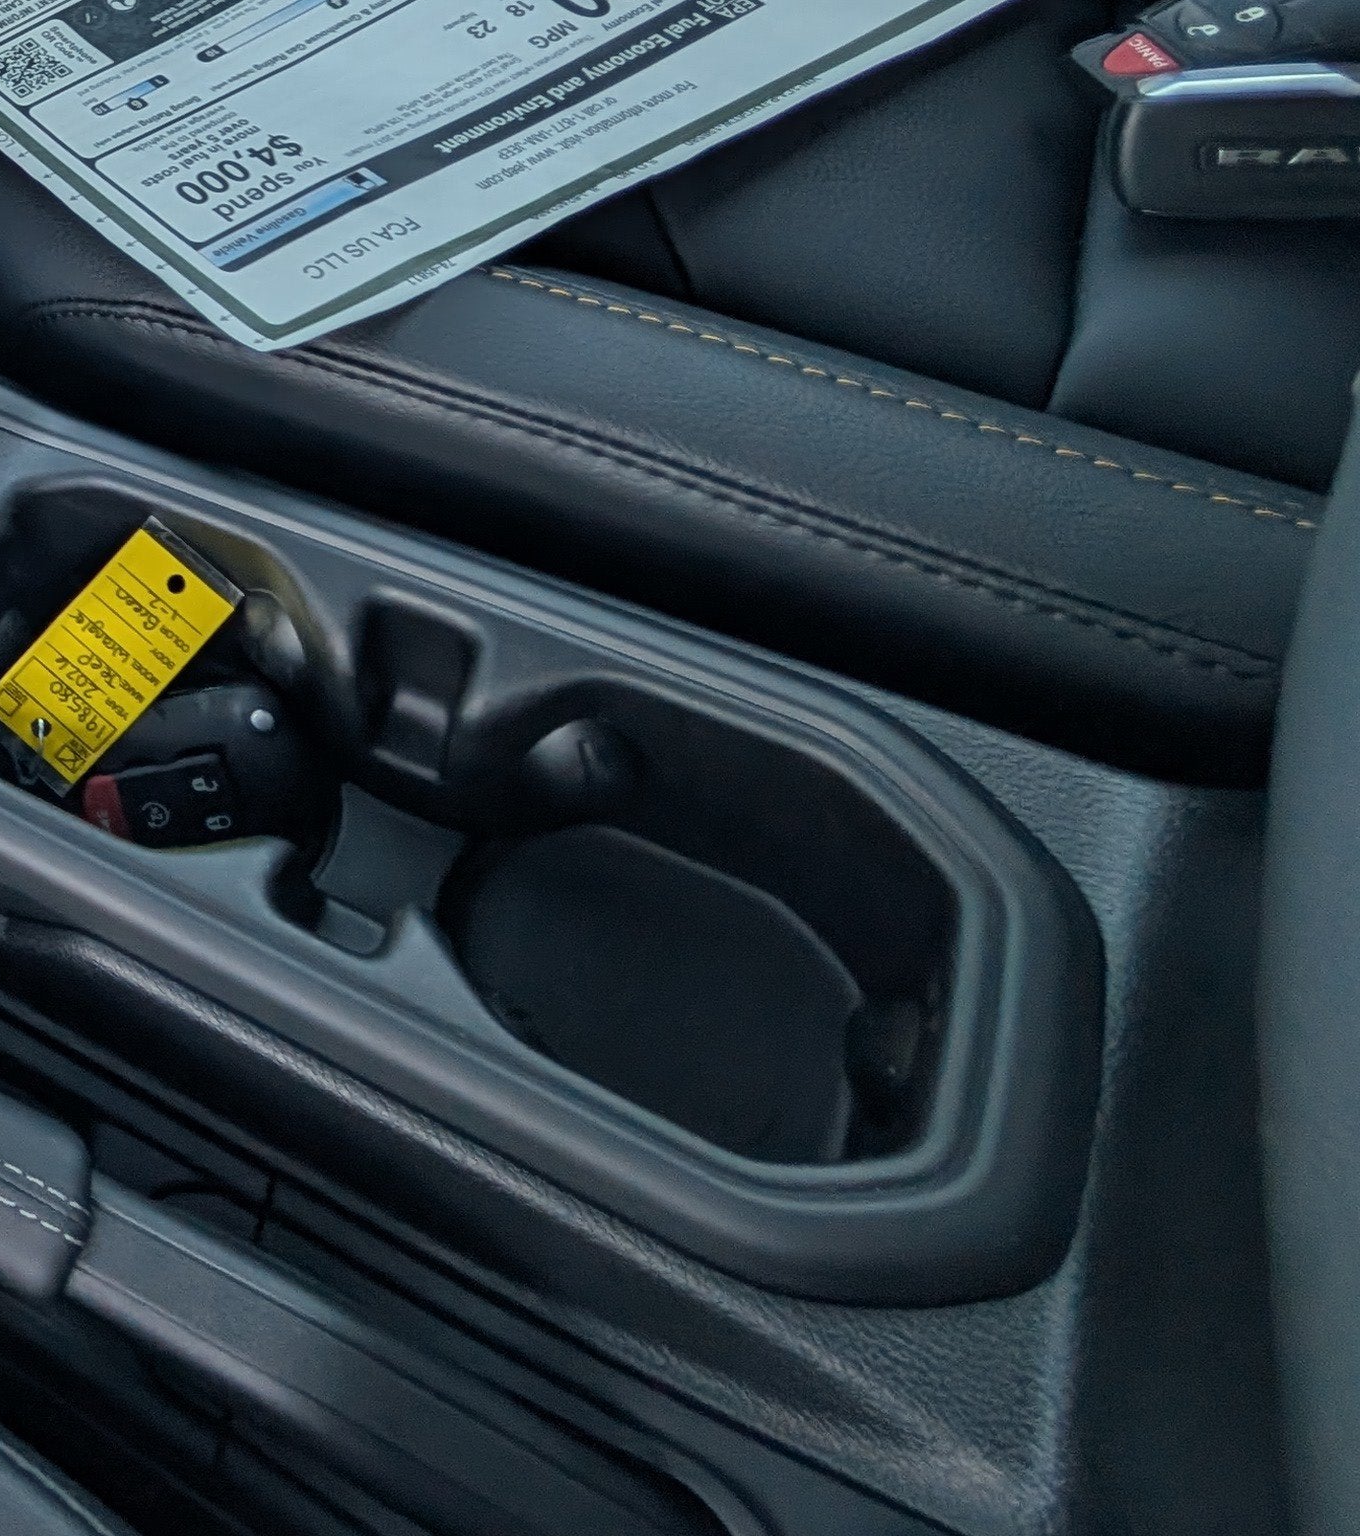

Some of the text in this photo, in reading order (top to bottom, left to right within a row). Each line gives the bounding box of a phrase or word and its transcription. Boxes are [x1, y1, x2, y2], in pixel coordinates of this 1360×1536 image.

[442, 11, 478, 30] highway
[505, 0, 534, 17] 18
[600, 3, 655, 31] Economy
[466, 19, 497, 38] 23
[527, 19, 578, 48] MPG
[662, 12, 711, 39] Fuel
[50, 25, 98, 65] Smartphone
[53, 39, 75, 60] Code
[581, 33, 672, 80] Economy
[1129, 38, 1170, 69] PANIC
[546, 76, 585, 100] and
[641, 89, 675, 107] more
[672, 80, 698, 93] For
[433, 94, 554, 153] Environment
[580, 104, 649, 136] information
[167, 118, 249, 160] over 5 years
[140, 125, 261, 186] more in fuel costs
[175, 134, 302, 204] $4,000
[474, 147, 557, 189] www.jeep.com
[211, 156, 327, 222] You spend
[212, 207, 307, 256] Gasoline Vehicle
[302, 216, 421, 279] FCA US LLC
[159, 624, 189, 652] COLOR
[131, 657, 160, 686] MODEL
[149, 648, 175, 669] BODY
[119, 679, 144, 703] MAKE
[49, 680, 110, 740] 198580
[104, 697, 128, 720] YEAR
